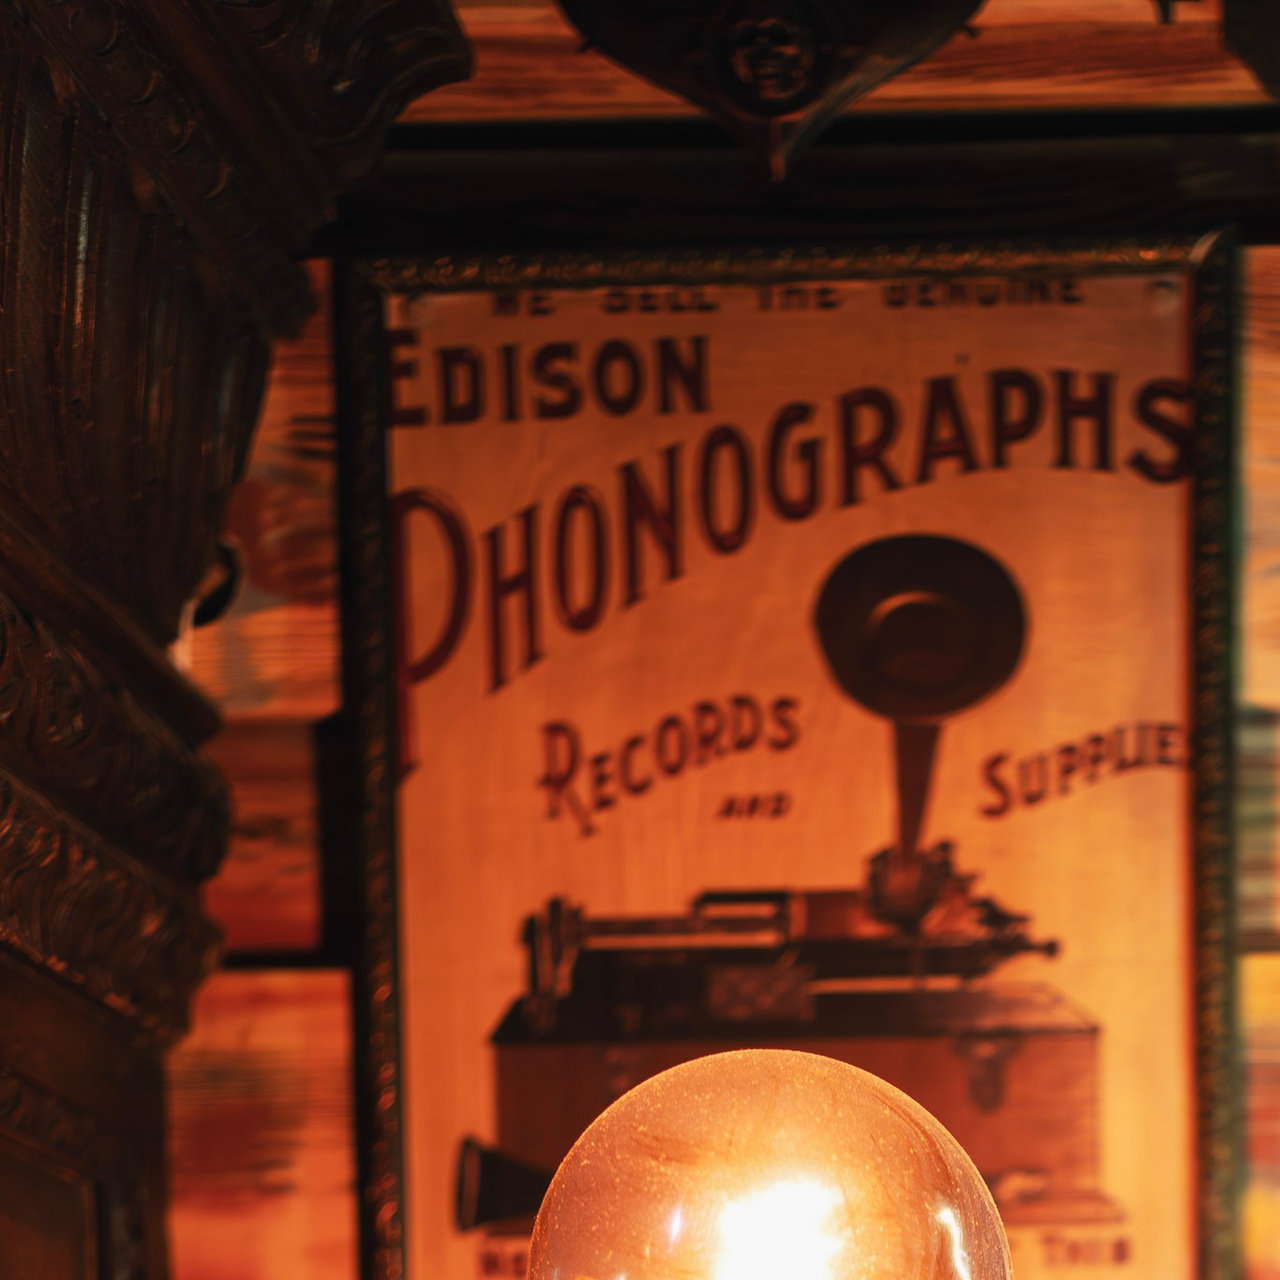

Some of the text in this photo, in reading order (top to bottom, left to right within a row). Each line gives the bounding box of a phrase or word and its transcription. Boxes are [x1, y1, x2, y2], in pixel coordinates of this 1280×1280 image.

[384, 329, 708, 427] EDISON
[390, 367, 1195, 785] PHONOGRAPHS
[537, 695, 800, 837] RECORDS
[978, 721, 1188, 819] SUPPLIE
